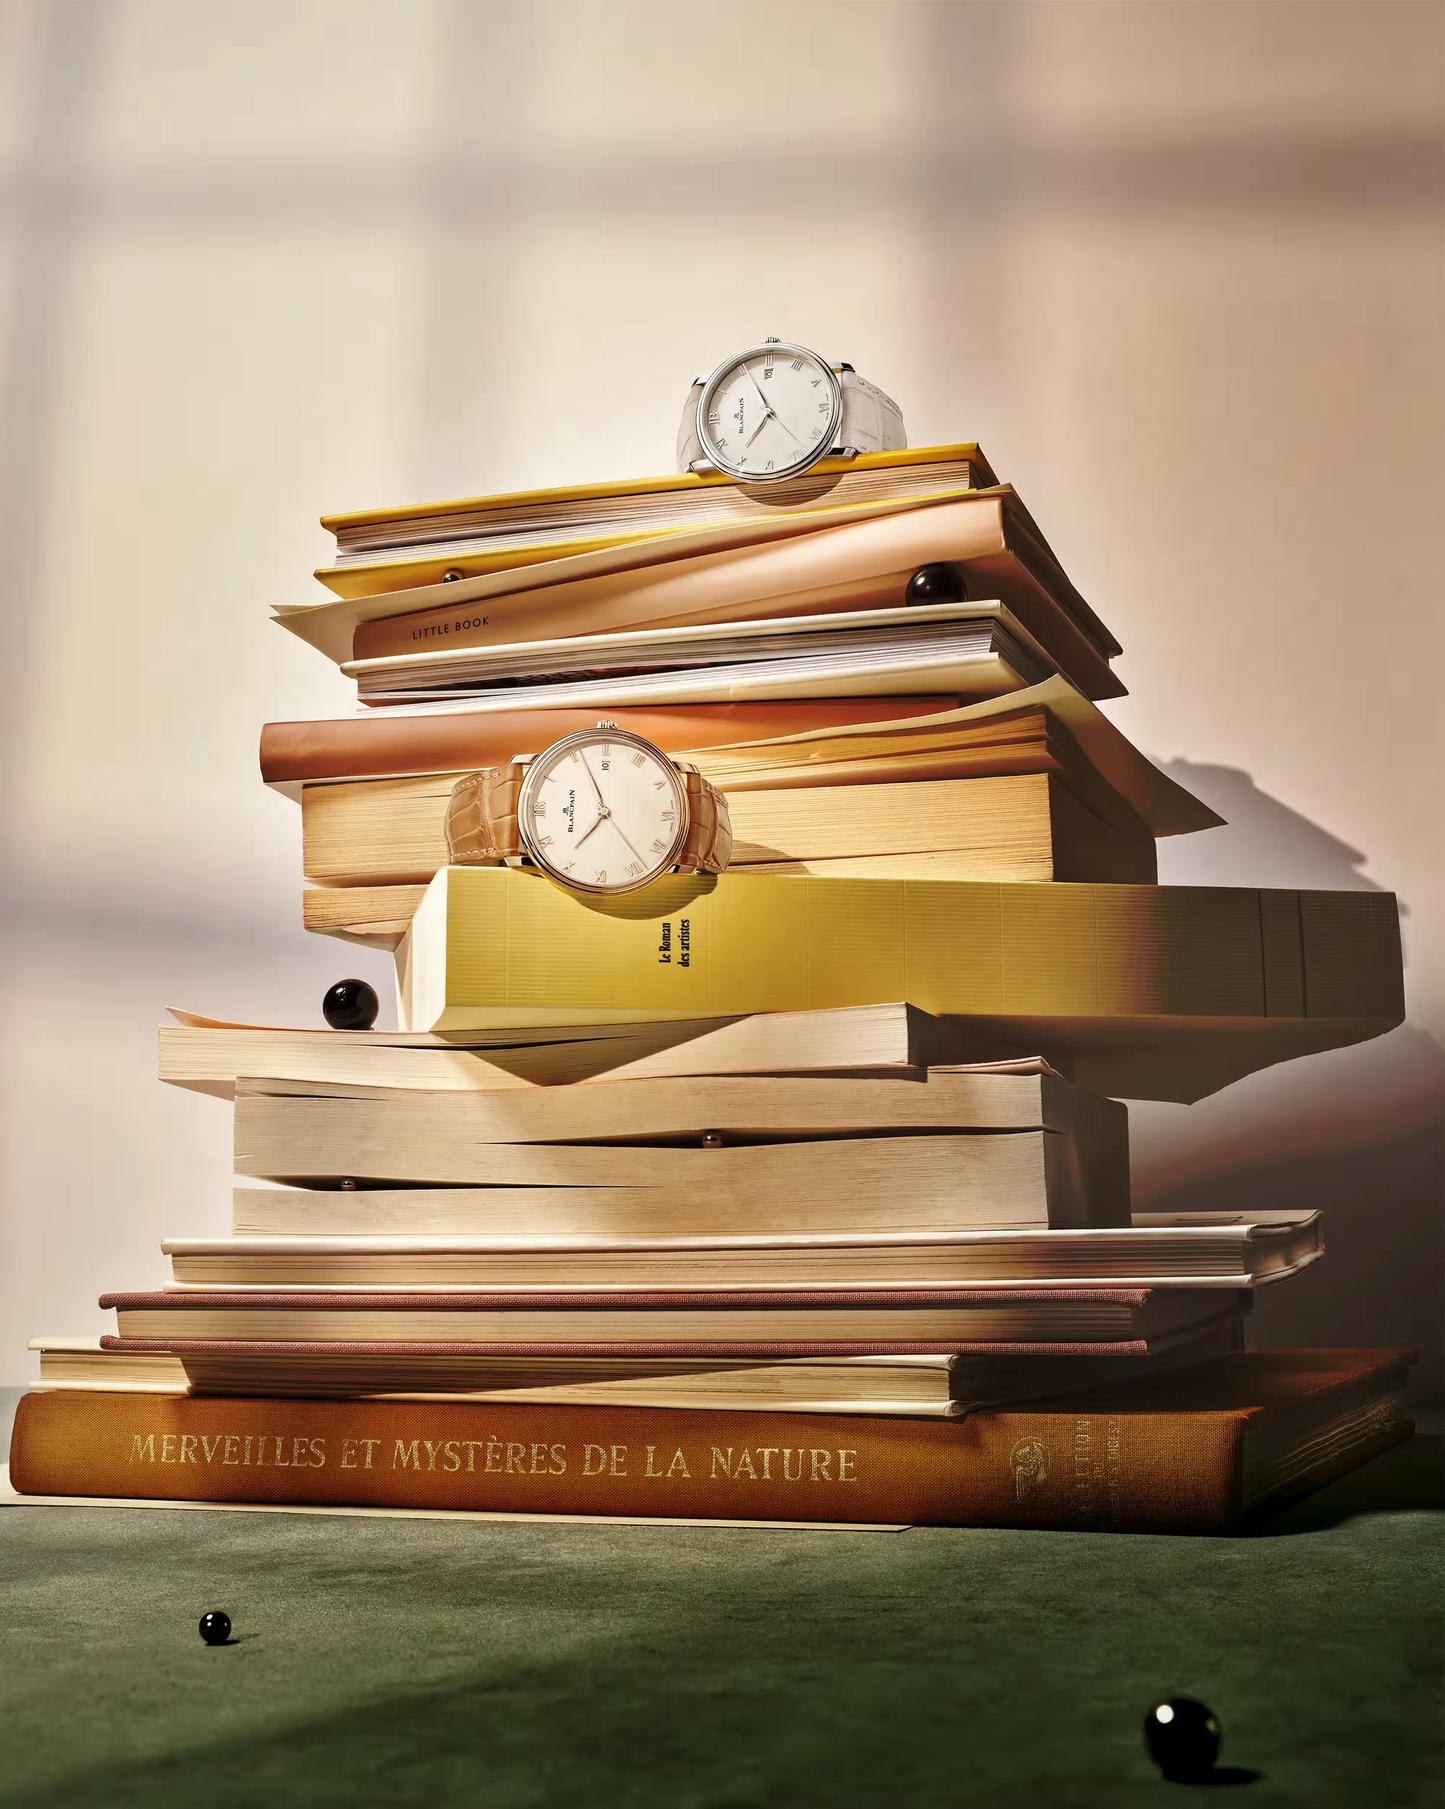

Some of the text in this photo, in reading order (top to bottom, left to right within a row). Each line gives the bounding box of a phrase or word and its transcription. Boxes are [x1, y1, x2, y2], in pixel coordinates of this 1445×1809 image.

[412, 616, 489, 640] LITTLE BOOK
[658, 922, 671, 963] Le Roman
[677, 919, 690, 967] des artistes
[129, 1434, 857, 1482] MERVEILLES ET MYSTÈRES DE LA NATURE
